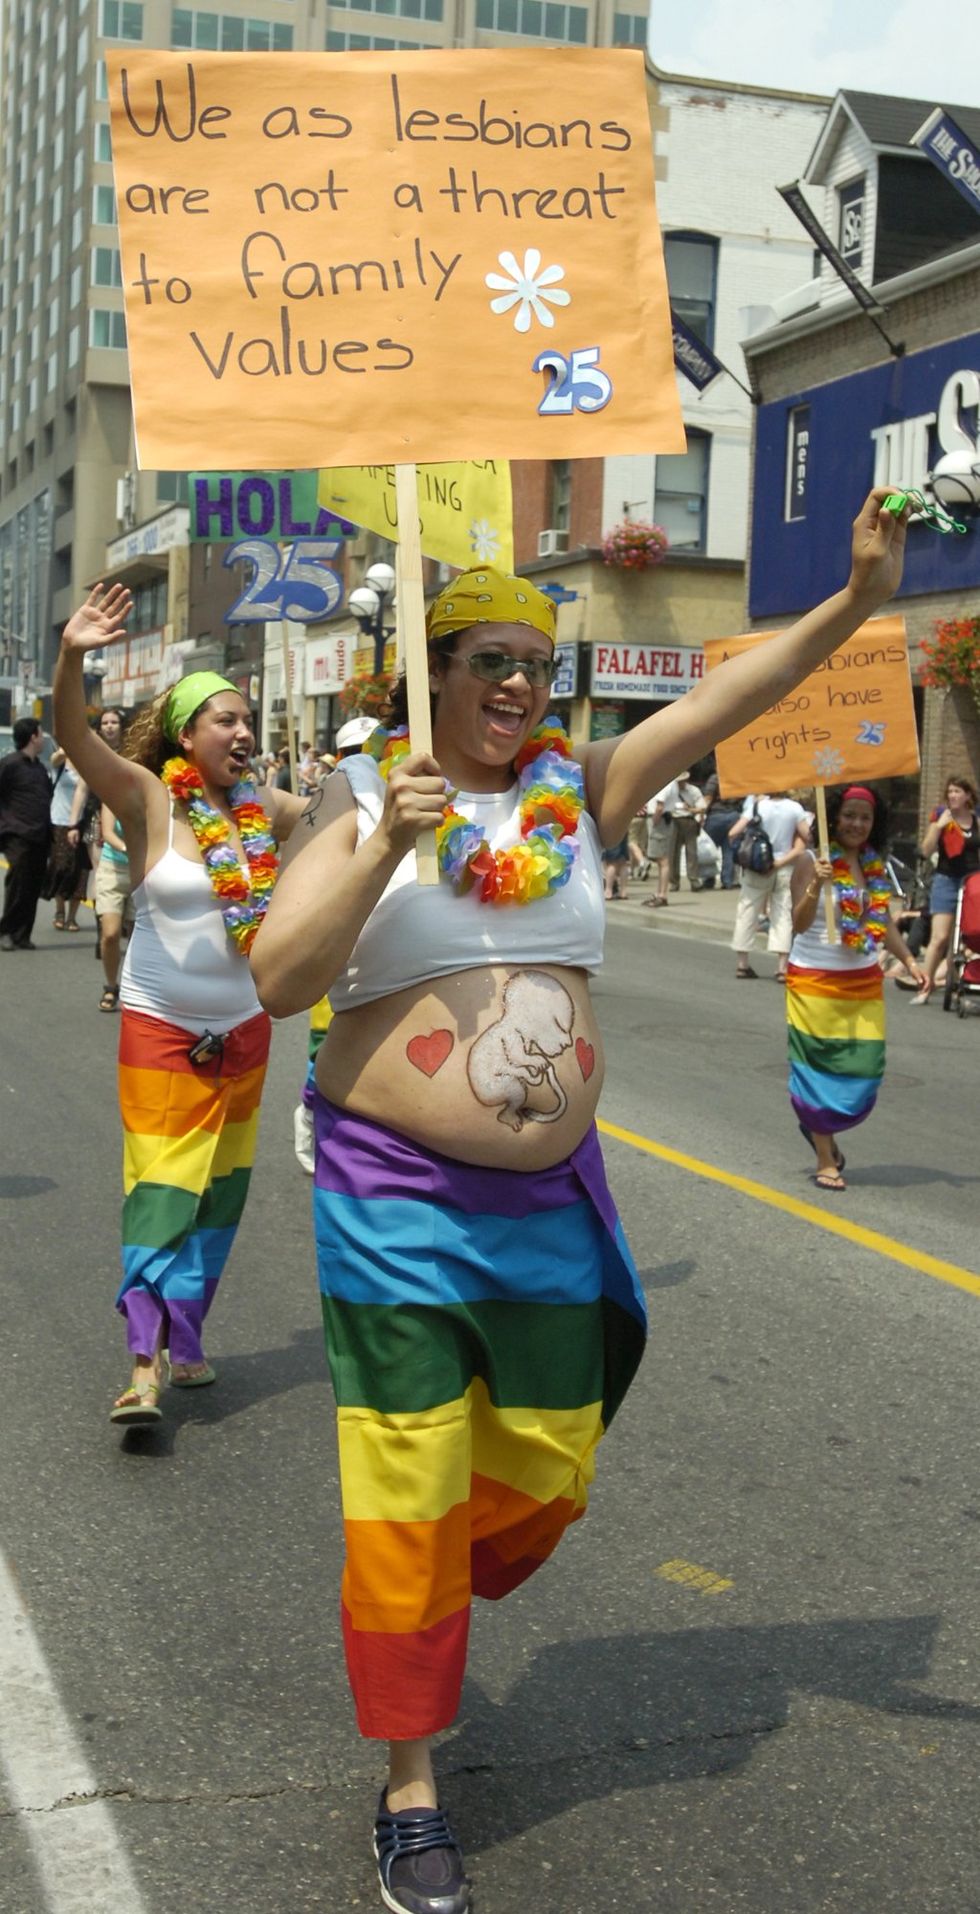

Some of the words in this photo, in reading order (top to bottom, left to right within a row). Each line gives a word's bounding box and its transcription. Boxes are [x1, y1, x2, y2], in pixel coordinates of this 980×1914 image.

[121, 63, 231, 142] We
[262, 106, 352, 139] as
[391, 73, 632, 151] lesbians
[125, 184, 209, 214] are
[254, 169, 348, 213] not
[394, 184, 423, 213] a
[439, 166, 625, 219] threat
[132, 252, 192, 304] to
[241, 231, 462, 301] family
[189, 306, 414, 379] values
[531, 346, 612, 415] 25
[797, 430, 809, 495] mens
[222, 536, 345, 626] 25
[334, 639, 346, 681] mudo
[596, 648, 684, 679] FALAFEL
[827, 685, 883, 707] have
[748, 723, 832, 760] rights
[855, 719, 887, 747] 25
